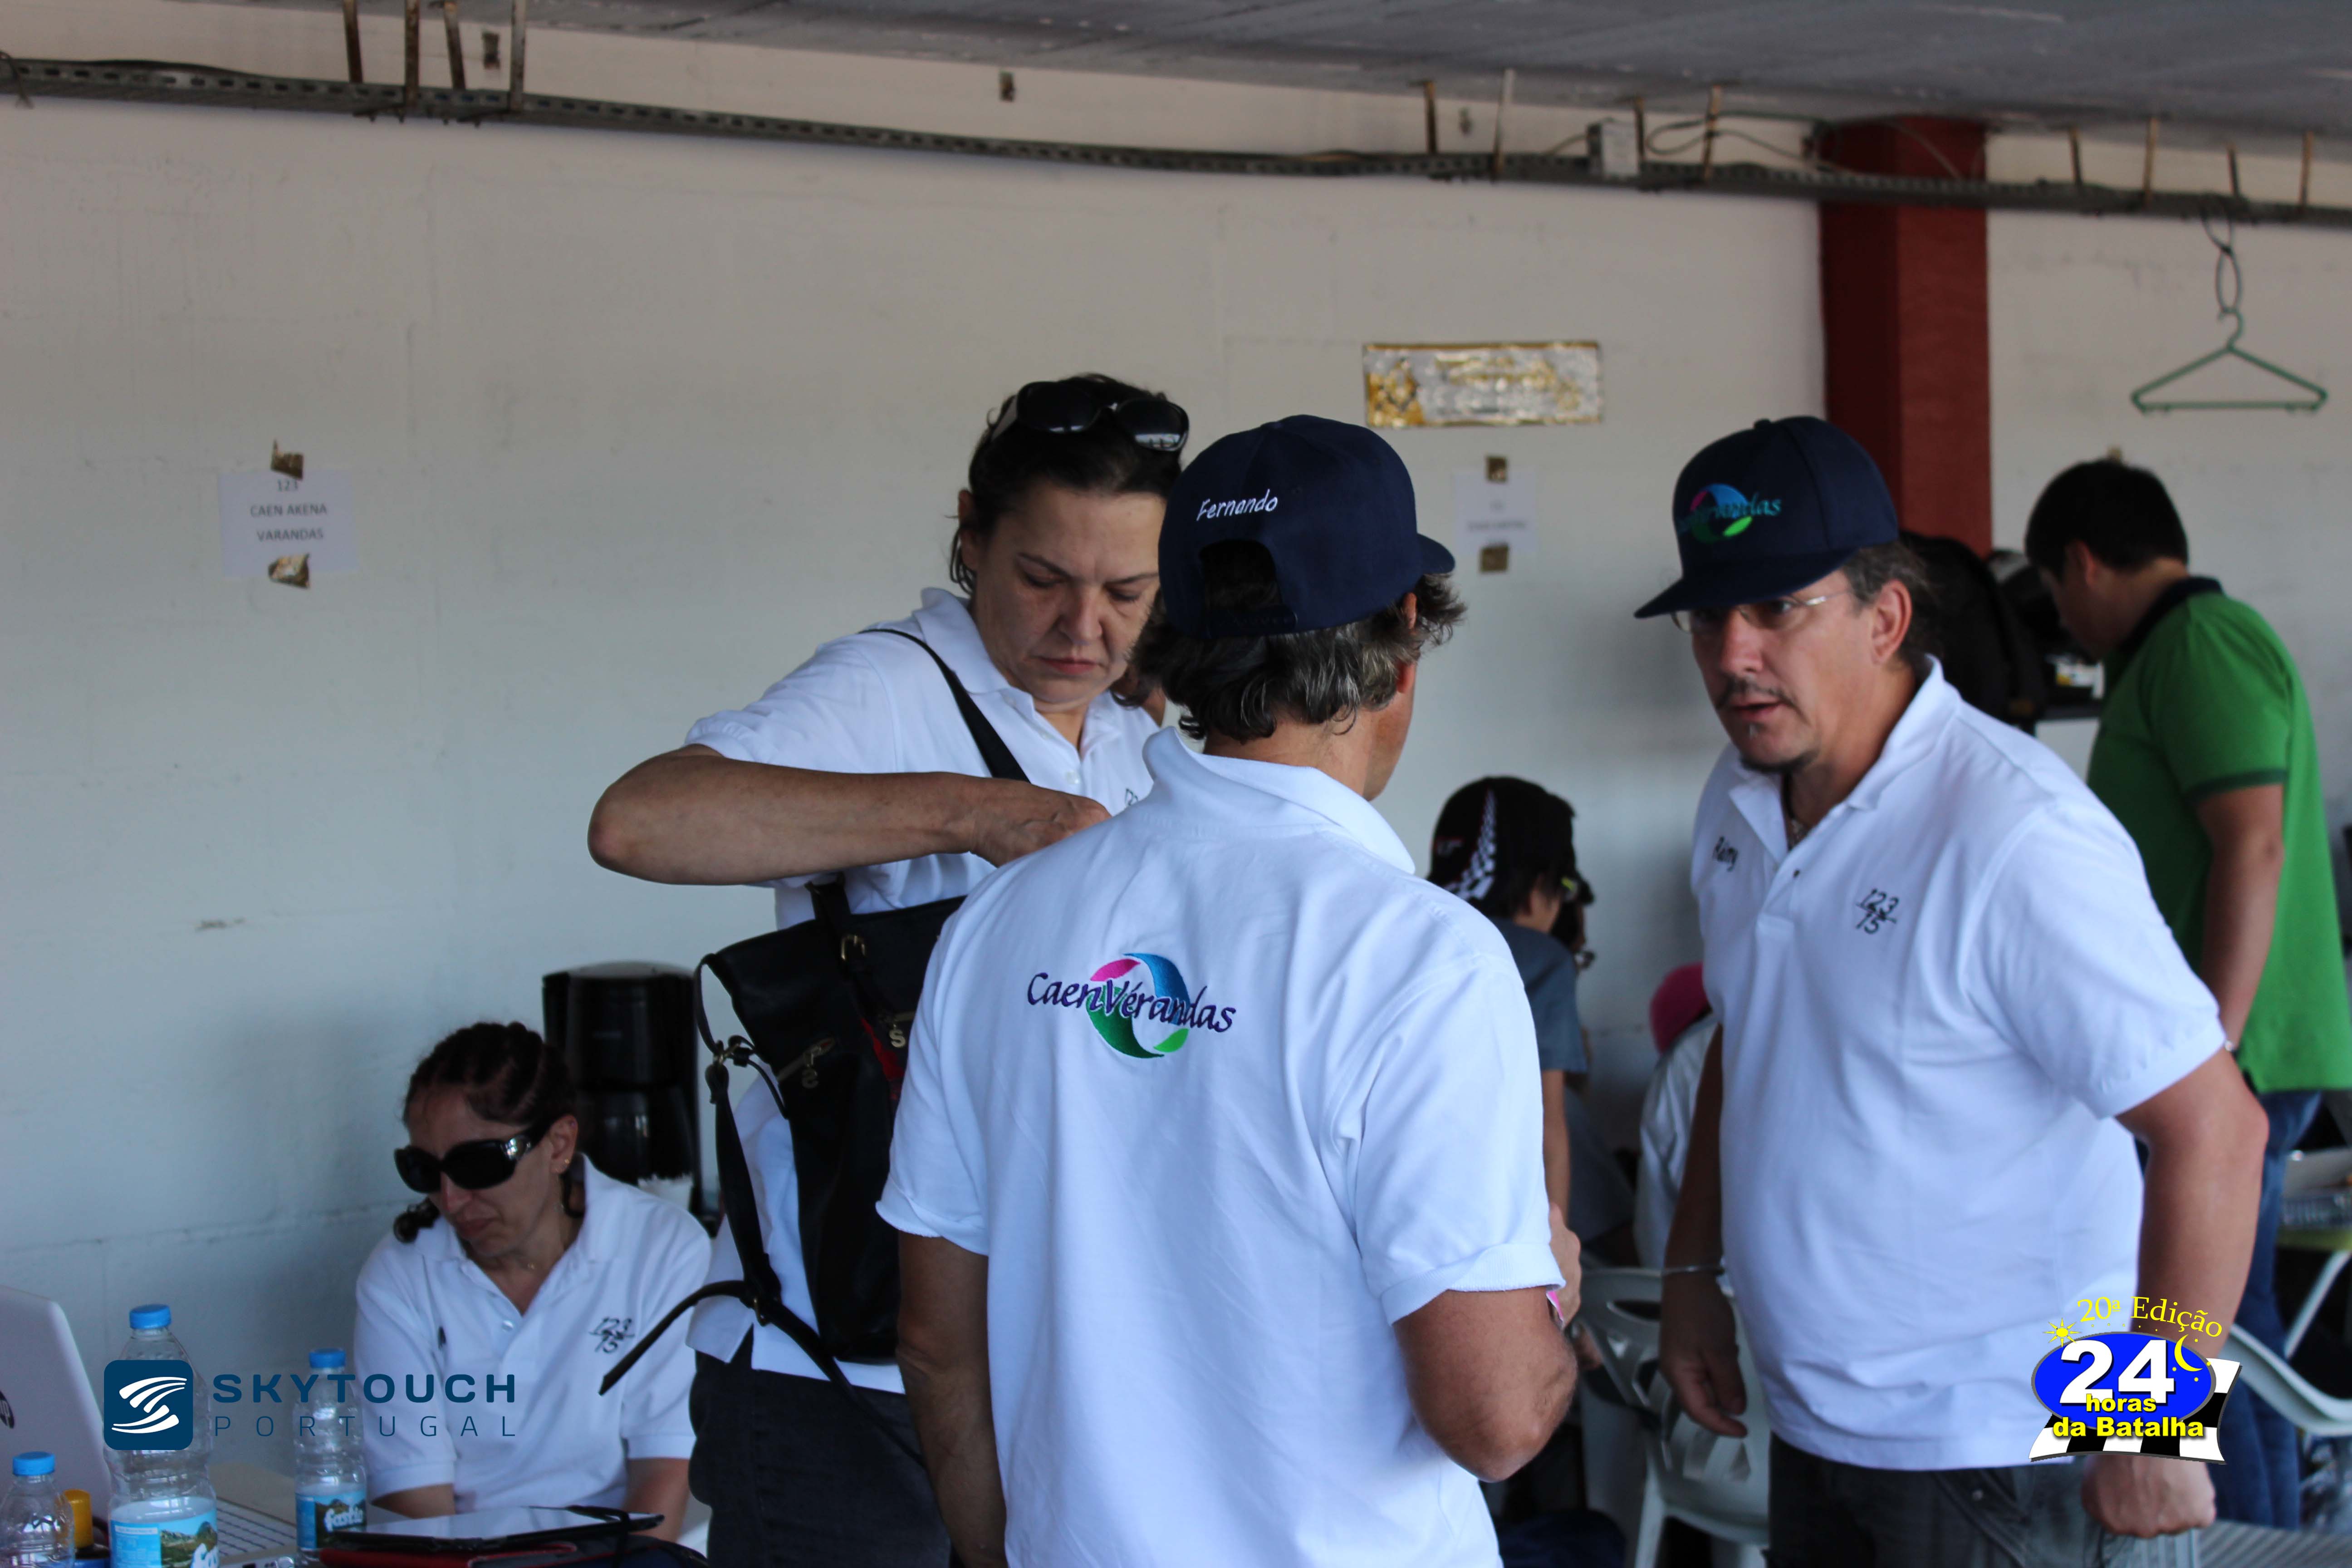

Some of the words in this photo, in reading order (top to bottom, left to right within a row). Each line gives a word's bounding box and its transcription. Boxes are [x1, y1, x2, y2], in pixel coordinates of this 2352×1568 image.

[250, 505, 283, 517] CAEN
[287, 503, 327, 515] AKENA
[1196, 489, 1278, 521] Fernando
[256, 528, 324, 542] VARANDAS
